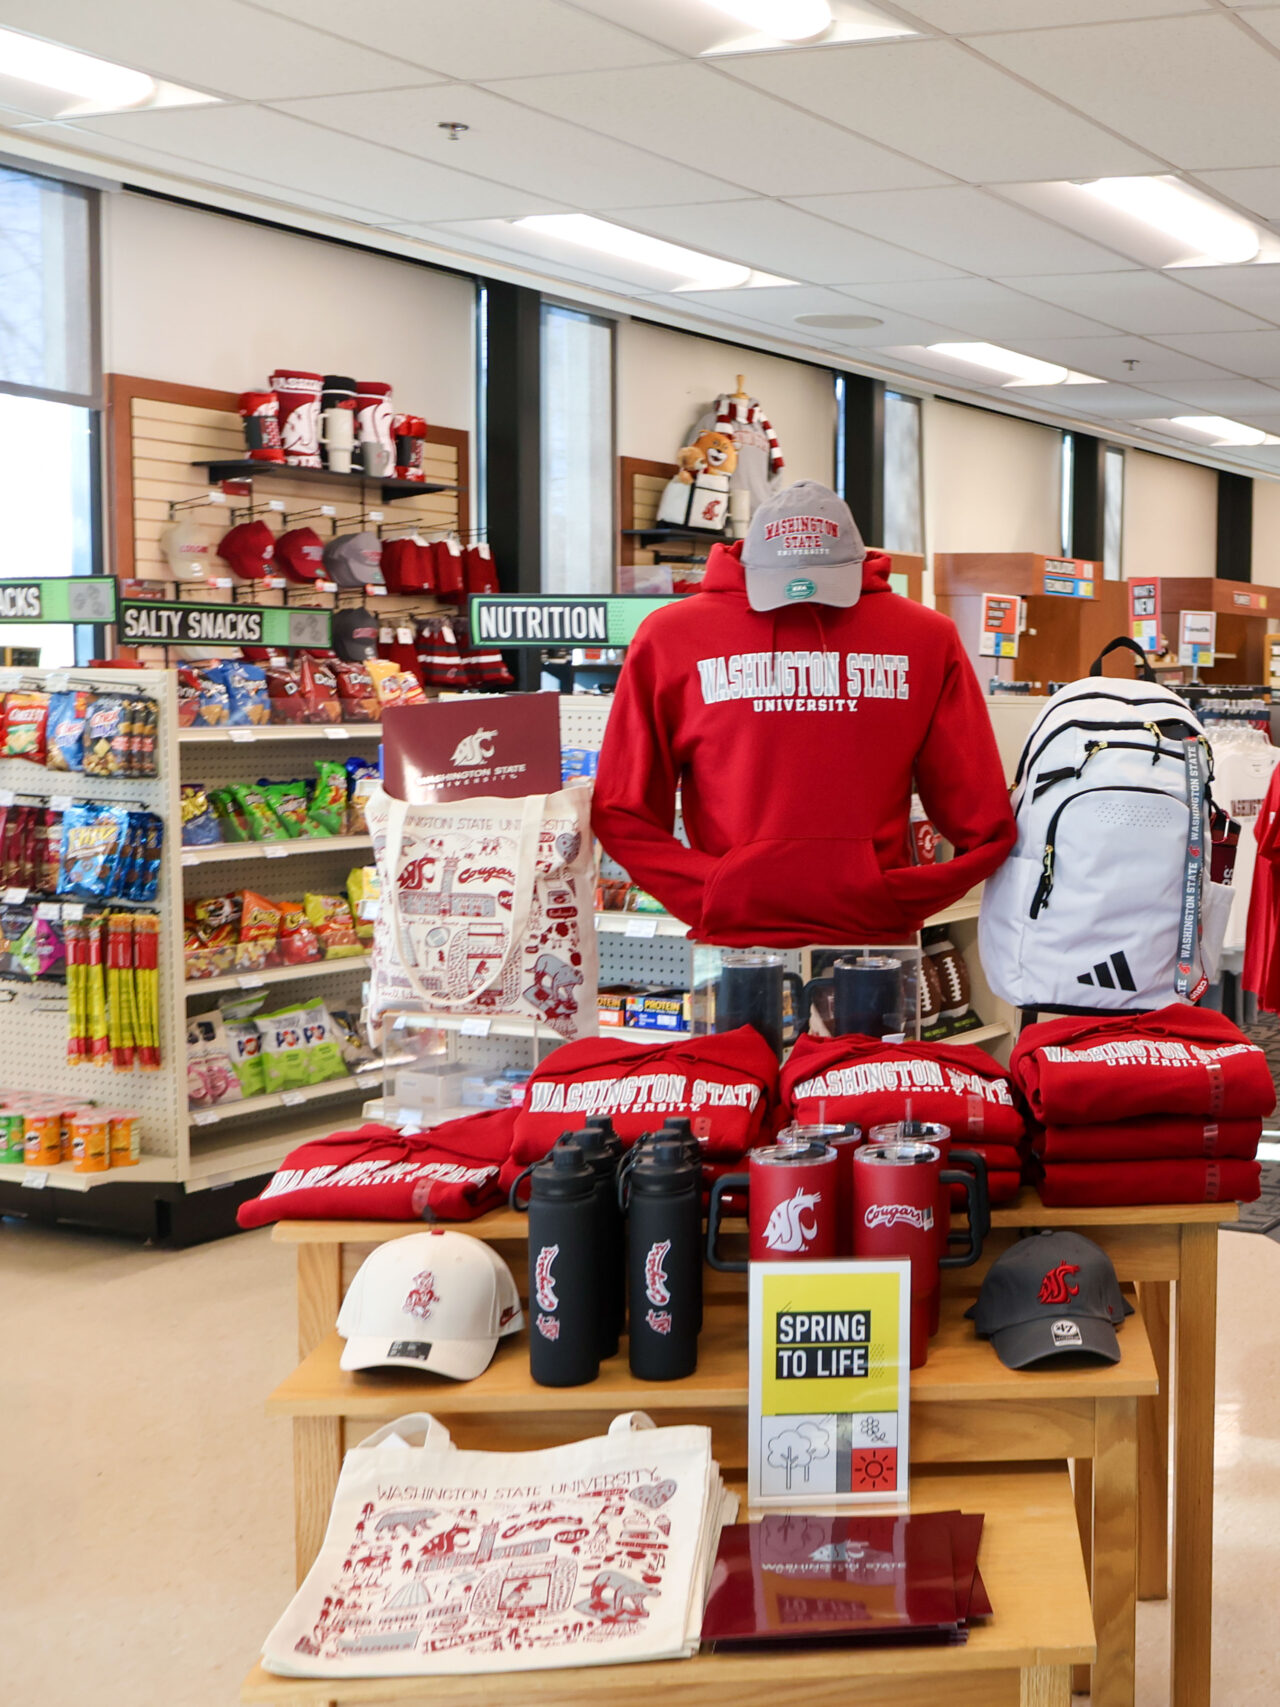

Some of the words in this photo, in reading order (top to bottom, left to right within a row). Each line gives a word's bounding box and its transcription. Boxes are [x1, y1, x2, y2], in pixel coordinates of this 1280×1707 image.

[764, 515, 840, 541] WASHINGTON
[777, 548, 830, 556] UNIVERSITY
[784, 535, 822, 548] STATE
[1134, 599, 1155, 616] NEW
[124, 608, 183, 637] SALTY
[187, 612, 261, 641] SNACKS
[479, 605, 606, 641] NUTRITION
[697, 651, 840, 705] WASHINGTON
[846, 653, 909, 700] STATE
[753, 699, 858, 712] UNIVERSITY
[1189, 745, 1200, 777] STATE
[417, 768, 492, 786] WASHINGTON
[494, 764, 527, 774] STATE
[1190, 779, 1202, 841] WASHINGTON
[456, 817, 493, 831] STATE
[1186, 862, 1198, 893] STATE
[1180, 896, 1196, 958] WASHINGTON
[645, 1000, 681, 1012] PROTEIN
[1040, 1039, 1191, 1062] WASHINGTON
[529, 1073, 687, 1113] WASHINGTON
[794, 1060, 944, 1100] WASHINGTON
[585, 1101, 700, 1117] UNIVERSITY
[865, 1204, 924, 1229] Cougars
[780, 1314, 866, 1343] SPRING
[779, 1349, 807, 1378] TO
[817, 1349, 866, 1376] LIFE
[377, 1484, 488, 1502] WASHINGTON
[495, 1486, 542, 1500] STATE
